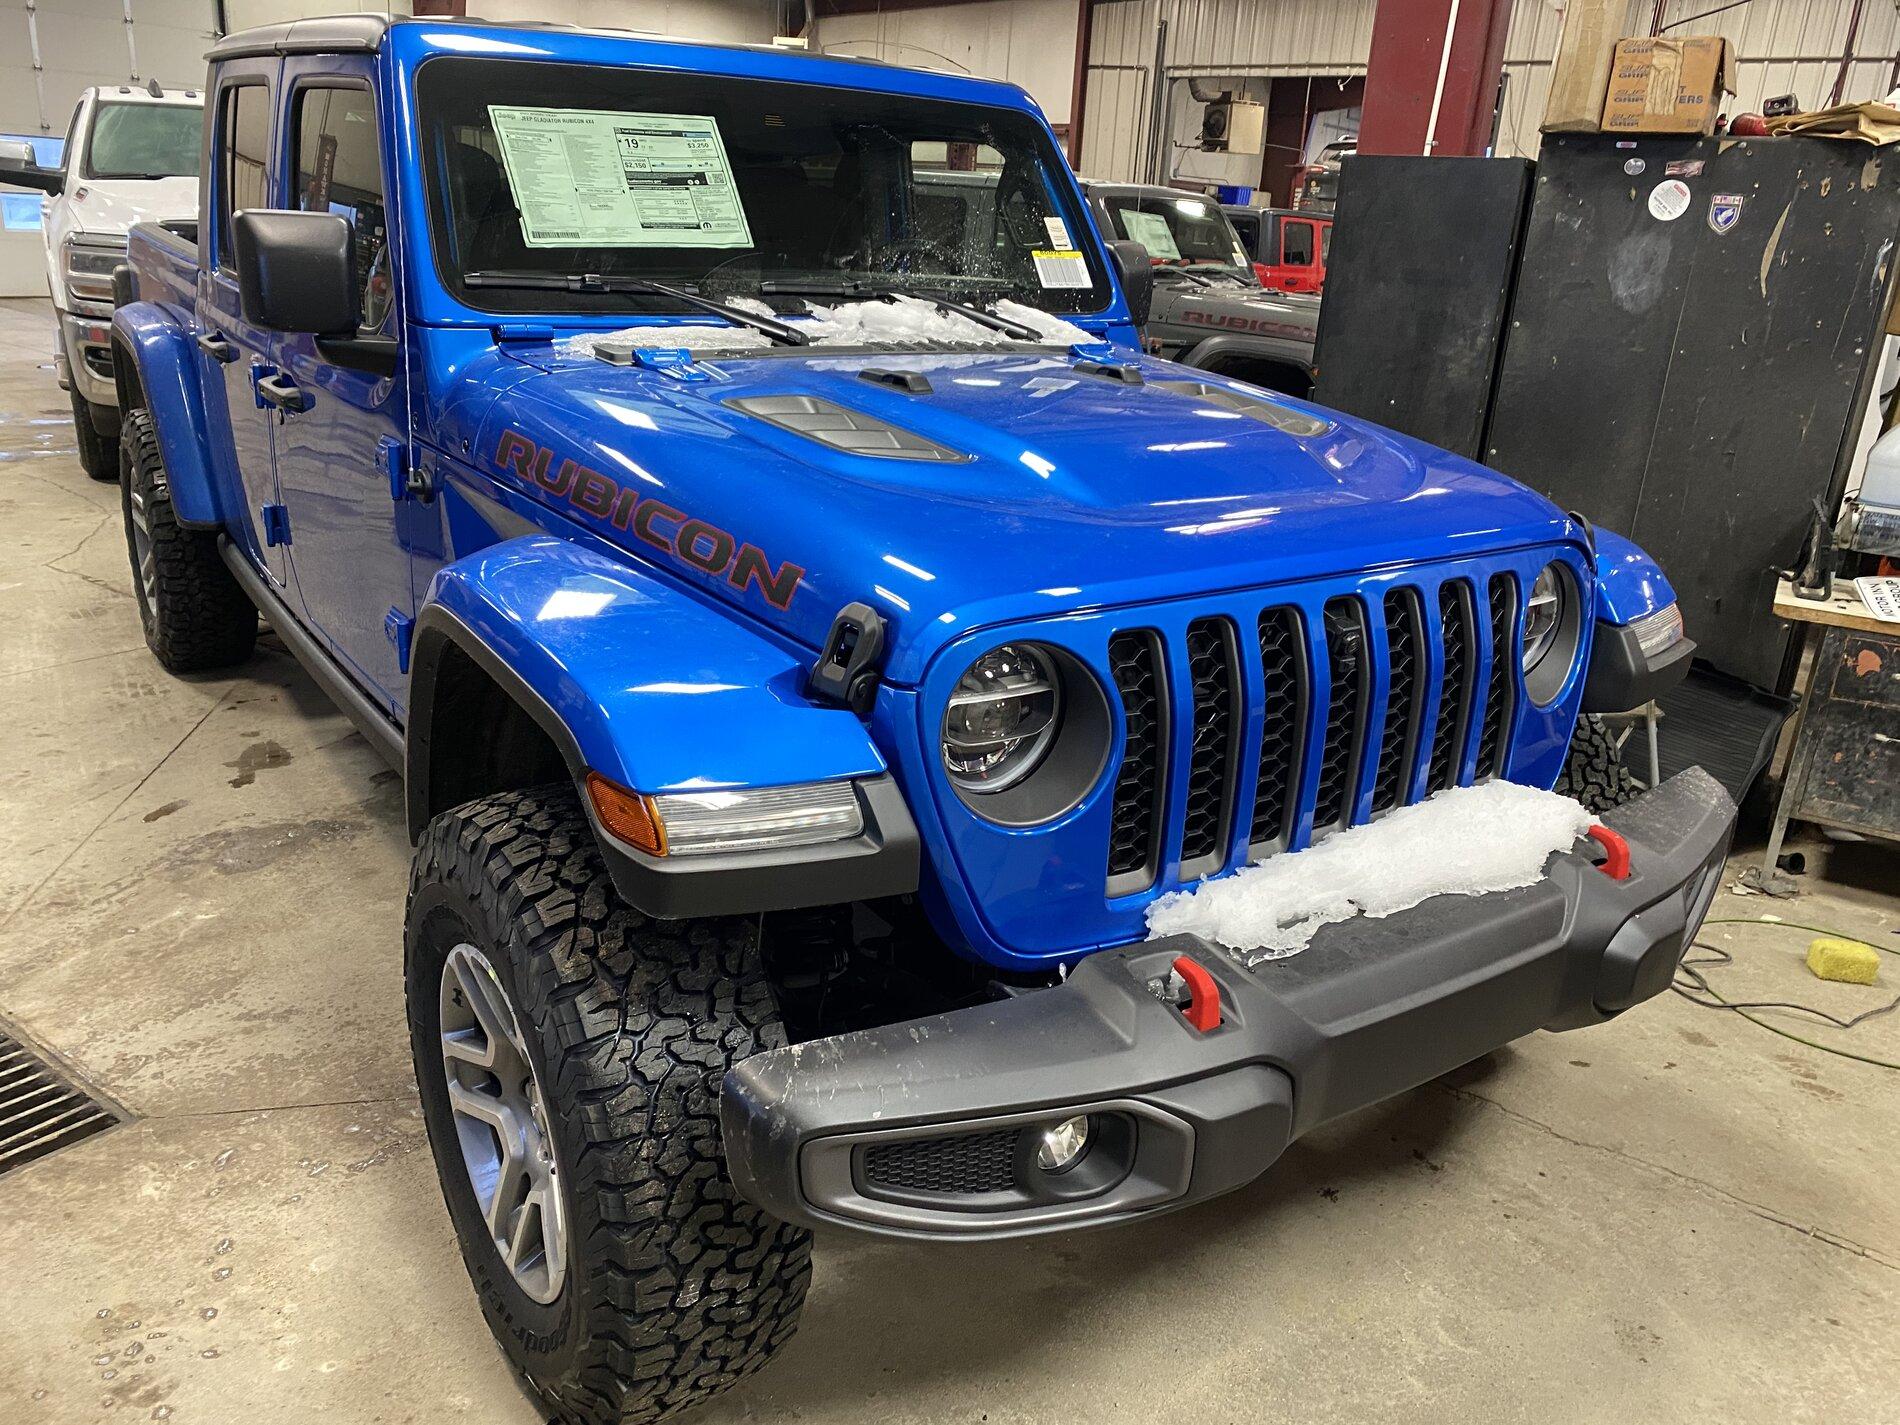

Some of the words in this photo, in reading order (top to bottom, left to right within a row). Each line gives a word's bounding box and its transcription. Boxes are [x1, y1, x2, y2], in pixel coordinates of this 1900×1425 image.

[624, 138, 639, 149] 19
[1181, 310, 1317, 338] RUBICON
[494, 428, 806, 612] RUBICON
